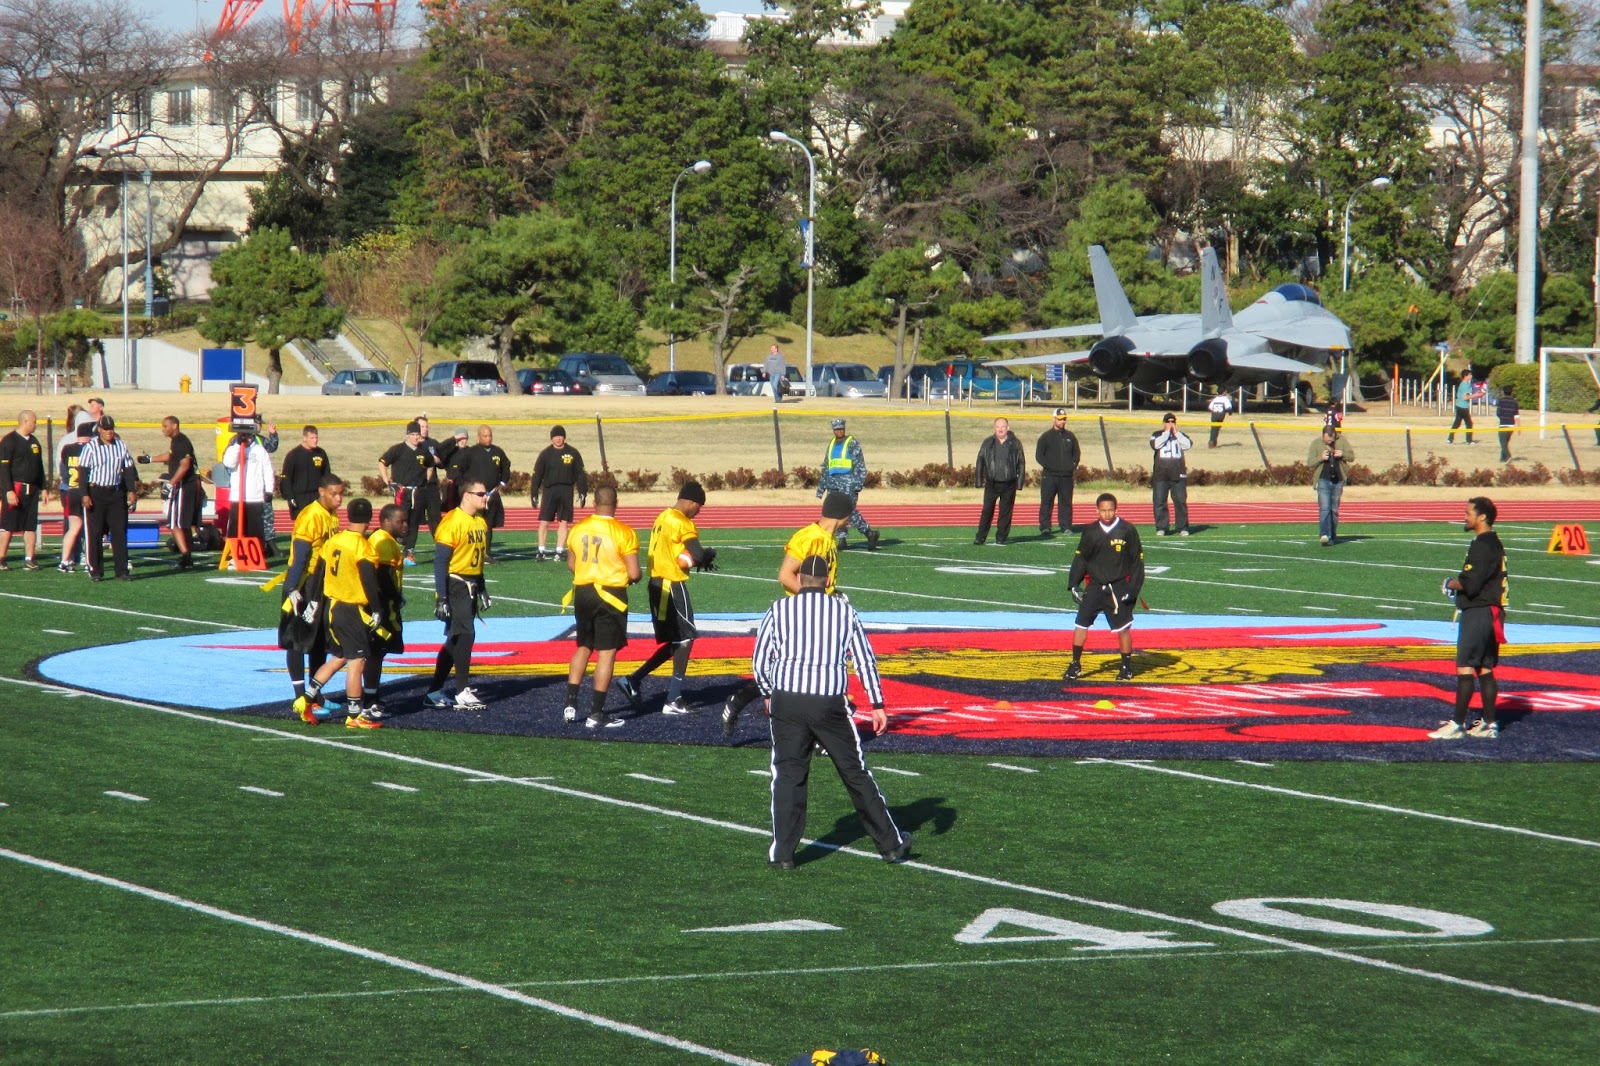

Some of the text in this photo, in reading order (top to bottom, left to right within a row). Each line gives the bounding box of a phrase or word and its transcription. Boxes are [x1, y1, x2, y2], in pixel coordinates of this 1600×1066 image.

[233, 387, 256, 416] 3
[1213, 403, 1224, 413] 55
[1160, 440, 1182, 459] 20
[581, 534, 602, 564] 17
[1115, 544, 1122, 552] 9
[1563, 526, 1586, 551] 20
[237, 539, 261, 566] 40
[331, 548, 342, 577] 3
[953, 897, 1495, 952] 40
